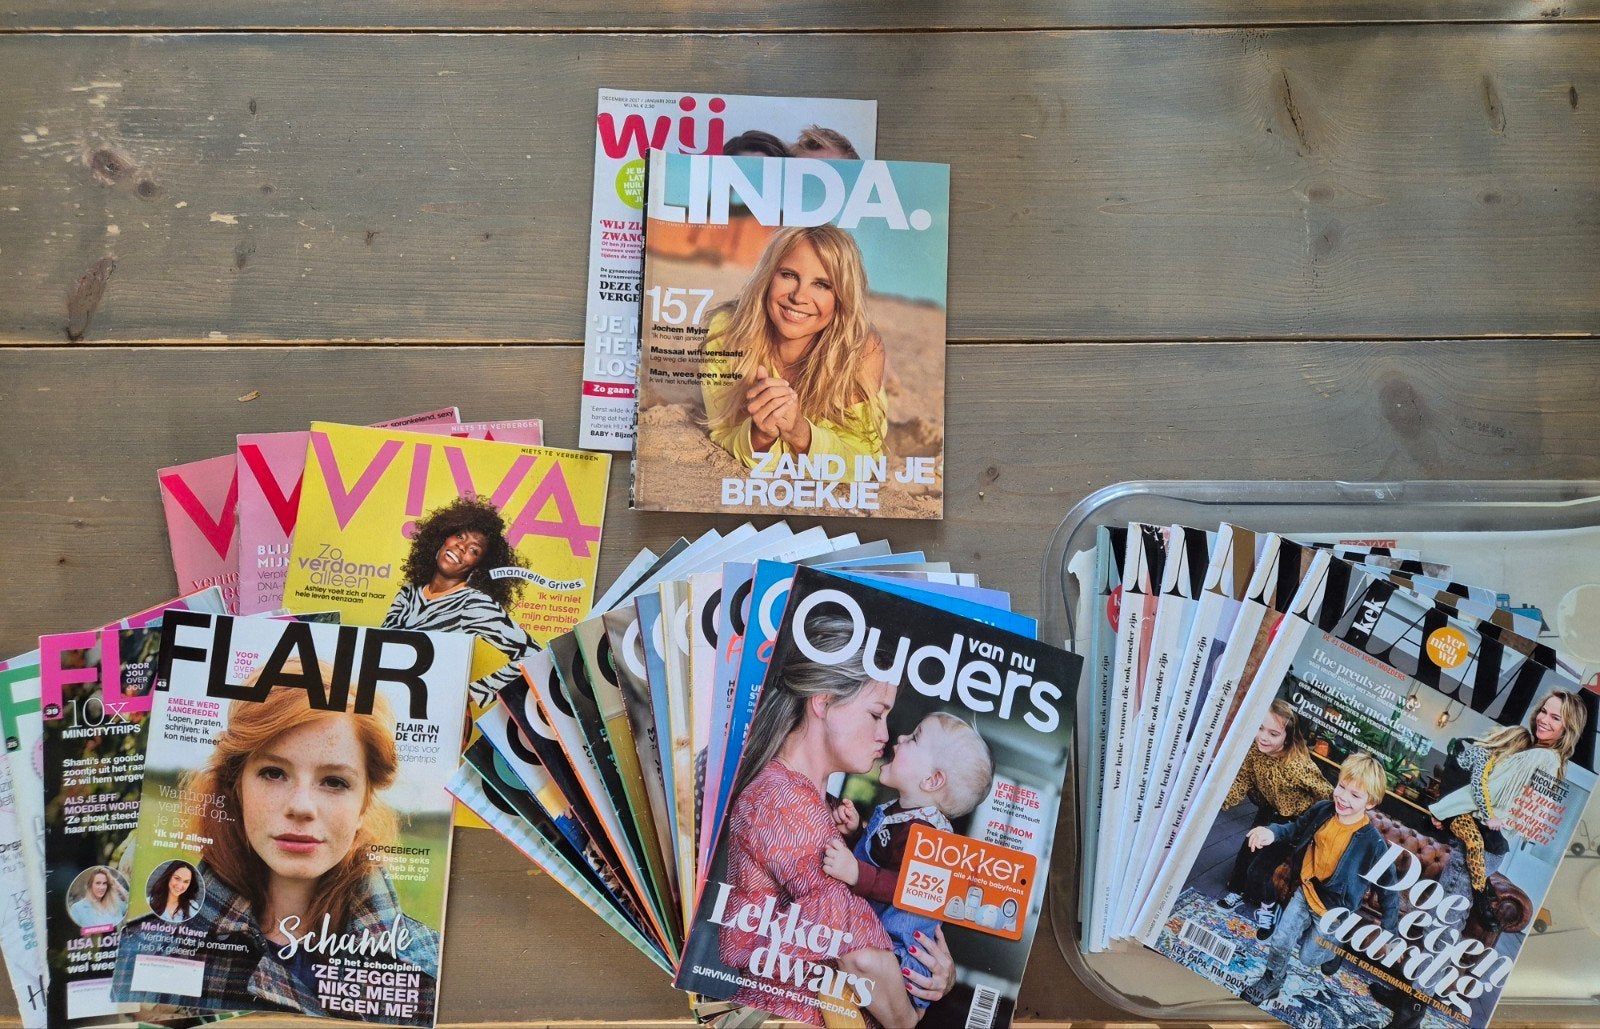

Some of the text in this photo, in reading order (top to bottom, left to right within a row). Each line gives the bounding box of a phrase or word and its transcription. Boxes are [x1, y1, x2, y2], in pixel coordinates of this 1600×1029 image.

[599, 280, 632, 292] DEZE
[599, 291, 640, 303] VERGE
[646, 286, 714, 325] 157
[652, 323, 684, 334] Jochem
[650, 346, 744, 358] Massaal wifi-verslaafd
[650, 368, 743, 381] Man, wees geen watje
[592, 384, 634, 396] Zo gaan
[490, 421, 539, 431] VERBERGEN
[590, 430, 610, 438] BABY
[521, 448, 600, 462] NIETS VERBERGEN
[749, 451, 936, 485] ZAND IN JE
[721, 477, 881, 511] BROEKJE
[317, 543, 343, 561] Zo
[298, 557, 392, 580] verdomd
[309, 571, 370, 590] alleen
[492, 568, 582, 591] Imanuelle Grives
[303, 584, 387, 600] Ashley voelt haar
[312, 592, 365, 604] leven eenzaam
[549, 593, 582, 604] wil niet
[516, 601, 581, 615] kiezen tussen
[521, 611, 580, 625] mijn ambitie
[1352, 597, 1386, 636] kek
[533, 624, 552, 633] een
[235, 650, 260, 660] VOOR
[791, 588, 1063, 734] Ouders
[968, 636, 1036, 673] van nu
[1437, 650, 1459, 667] wd
[125, 662, 150, 671] VOOR
[154, 609, 435, 720] FLAIR
[234, 658, 253, 667] JOU
[126, 676, 149, 684] OVER
[232, 671, 250, 680] JOU
[1311, 648, 1398, 702] Hoe preuts zijn
[1119, 631, 1136, 740] vrouwen moeder
[1300, 669, 1367, 711] Chaotische
[168, 697, 220, 710] EMELIE WERD
[1169, 654, 1202, 760] vrouwen moeder
[67, 697, 130, 730] 10x
[166, 705, 219, 718] AANGEREDEN
[1288, 691, 1363, 736] Open relatie
[164, 723, 201, 734] schrijven:
[194, 718, 224, 729] praten,
[395, 722, 440, 734] FLAIR IN
[1143, 669, 1164, 775] vrouwen moeder
[62, 724, 142, 740] MINICITYTRIPS
[163, 731, 179, 741] kon
[179, 735, 199, 744] niets
[395, 731, 438, 744] DE CITY!
[1183, 697, 1226, 802] vrouwen moeder
[62, 753, 145, 769] Shanti's ex gooide
[62, 763, 127, 778] zoontje uit het
[63, 774, 112, 787] Ze wil hem
[1530, 773, 1569, 797] NICOLETTE
[64, 793, 118, 806] ALS JE BFF
[158, 784, 227, 810] Wanhopig
[64, 802, 108, 816] MOEDER
[158, 800, 208, 818] verliefd
[83, 812, 110, 824] showt
[171, 816, 189, 829] ex
[64, 824, 88, 836] haar
[987, 820, 1034, 840] #FATMOM
[153, 838, 178, 850] maar
[169, 831, 214, 846] wil alleen
[370, 844, 431, 857] OPGEBIECHT
[382, 854, 430, 866] beste seks
[389, 862, 430, 875] heb op
[907, 870, 946, 895] 25%
[953, 871, 1025, 896] alle Alecto babyfoons
[1356, 839, 1471, 925] Doe
[905, 887, 943, 904] KORTING
[706, 881, 854, 960] Lekker
[140, 921, 209, 939] Melody Klaver
[277, 912, 414, 961] Schande
[67, 937, 94, 951] LISA
[137, 941, 155, 952] heb
[1397, 909, 1516, 989] even
[67, 963, 90, 975] wel
[328, 957, 423, 972] op het schoolplein
[748, 935, 876, 1008] dwars
[343, 966, 421, 988] ZEGGEN
[1170, 944, 1298, 1019] KEK TIM DOUWSMA MAMA
[1333, 946, 1454, 1016] UIT DIE KRABBENMAND, ZEGT TANJA
[318, 979, 420, 1004] NIKS MEER
[691, 964, 859, 1021] SURVIVALGIDS VOOR PEUTERGEDRAG
[318, 994, 381, 1015] TEGEN
